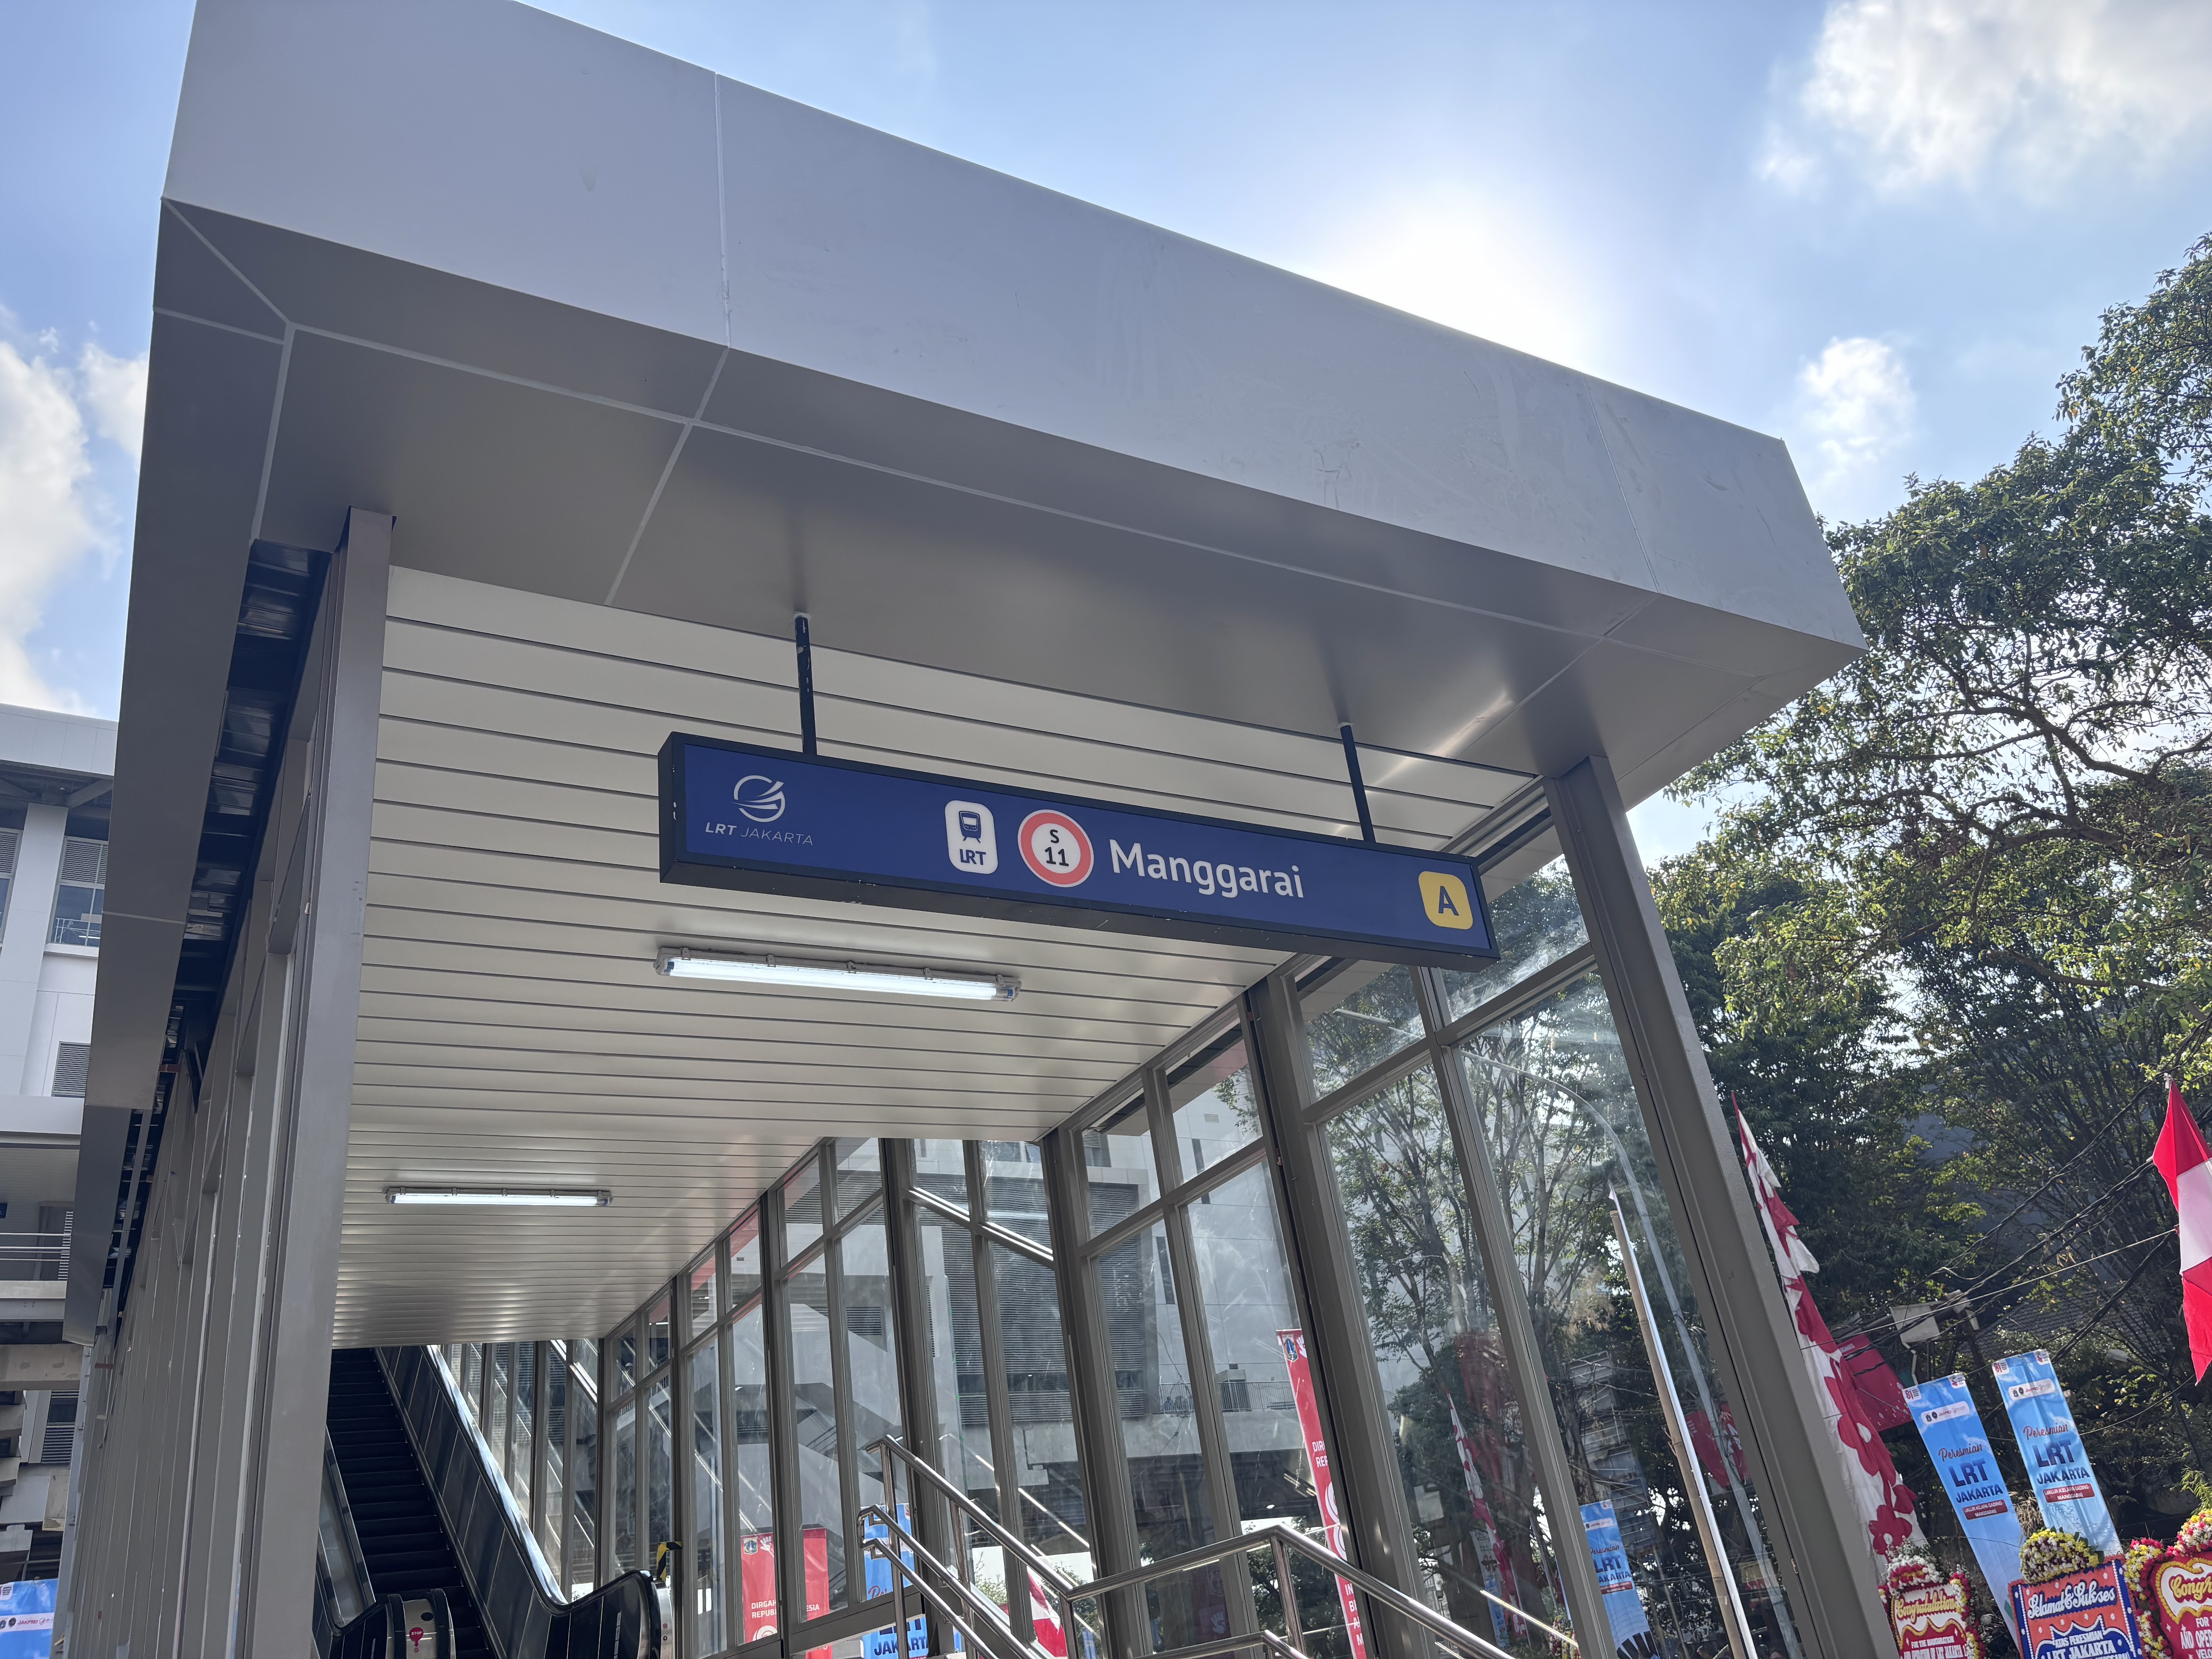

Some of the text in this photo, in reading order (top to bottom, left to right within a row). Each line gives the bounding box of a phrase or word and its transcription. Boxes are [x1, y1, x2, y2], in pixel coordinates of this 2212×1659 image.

[705, 822, 813, 845] LRT JAKARTA
[1050, 830, 1060, 843] S
[960, 848, 986, 865] LRT
[1045, 847, 1069, 867] 11
[1109, 839, 1304, 898] Manggarai
[1438, 886, 1460, 916] A
[2023, 1422, 2068, 1440] Peresmian
[1938, 1443, 1982, 1462] Peresmian
[2032, 1439, 2075, 1468] LRT
[1948, 1458, 1988, 1487] LRT
[2037, 1466, 2090, 1485] JAKARTA
[1955, 1484, 2003, 1503] JAKARTA
[1593, 1555, 1621, 1573] LRT
[2073, 1581, 2116, 1607] Sukses
[1897, 1590, 1957, 1622] Congratulation
[2196, 1617, 2210, 1628] FOR
[2055, 1630, 2104, 1649] ATAS PERESMIAN
[2180, 1631, 2194, 1649] AND
[2068, 1640, 2116, 1659] JAKARTA
